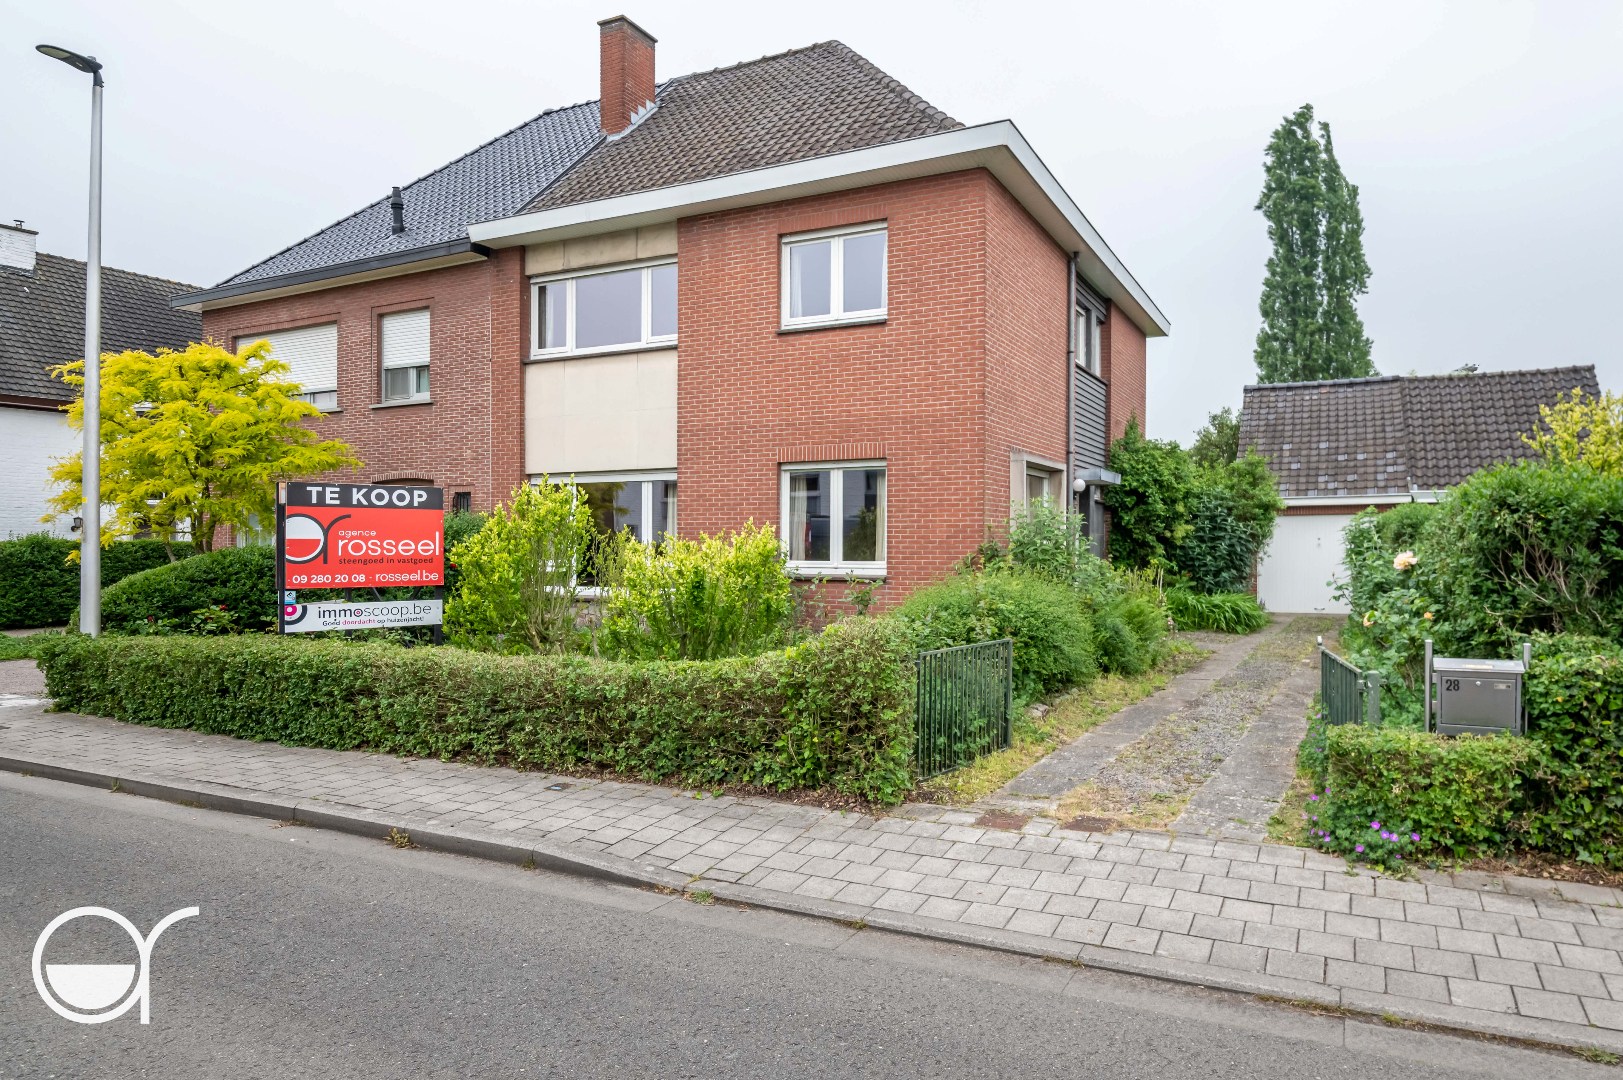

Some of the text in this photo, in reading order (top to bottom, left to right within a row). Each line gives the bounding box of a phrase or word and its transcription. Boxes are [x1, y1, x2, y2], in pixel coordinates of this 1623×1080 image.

[306, 486, 428, 507] TE KOOP
[338, 530, 377, 538] agence
[338, 531, 439, 556] rosseel
[338, 557, 384, 566] steengoed
[397, 557, 434, 566] vastgoed
[292, 574, 308, 584] 09
[310, 574, 332, 583] 280
[334, 574, 349, 583] 20
[351, 574, 366, 583] 08
[375, 569, 439, 582] rosseel.be
[318, 603, 432, 620] immoscoop.be
[341, 618, 376, 626] doordacht
[1445, 679, 1460, 692] 28
